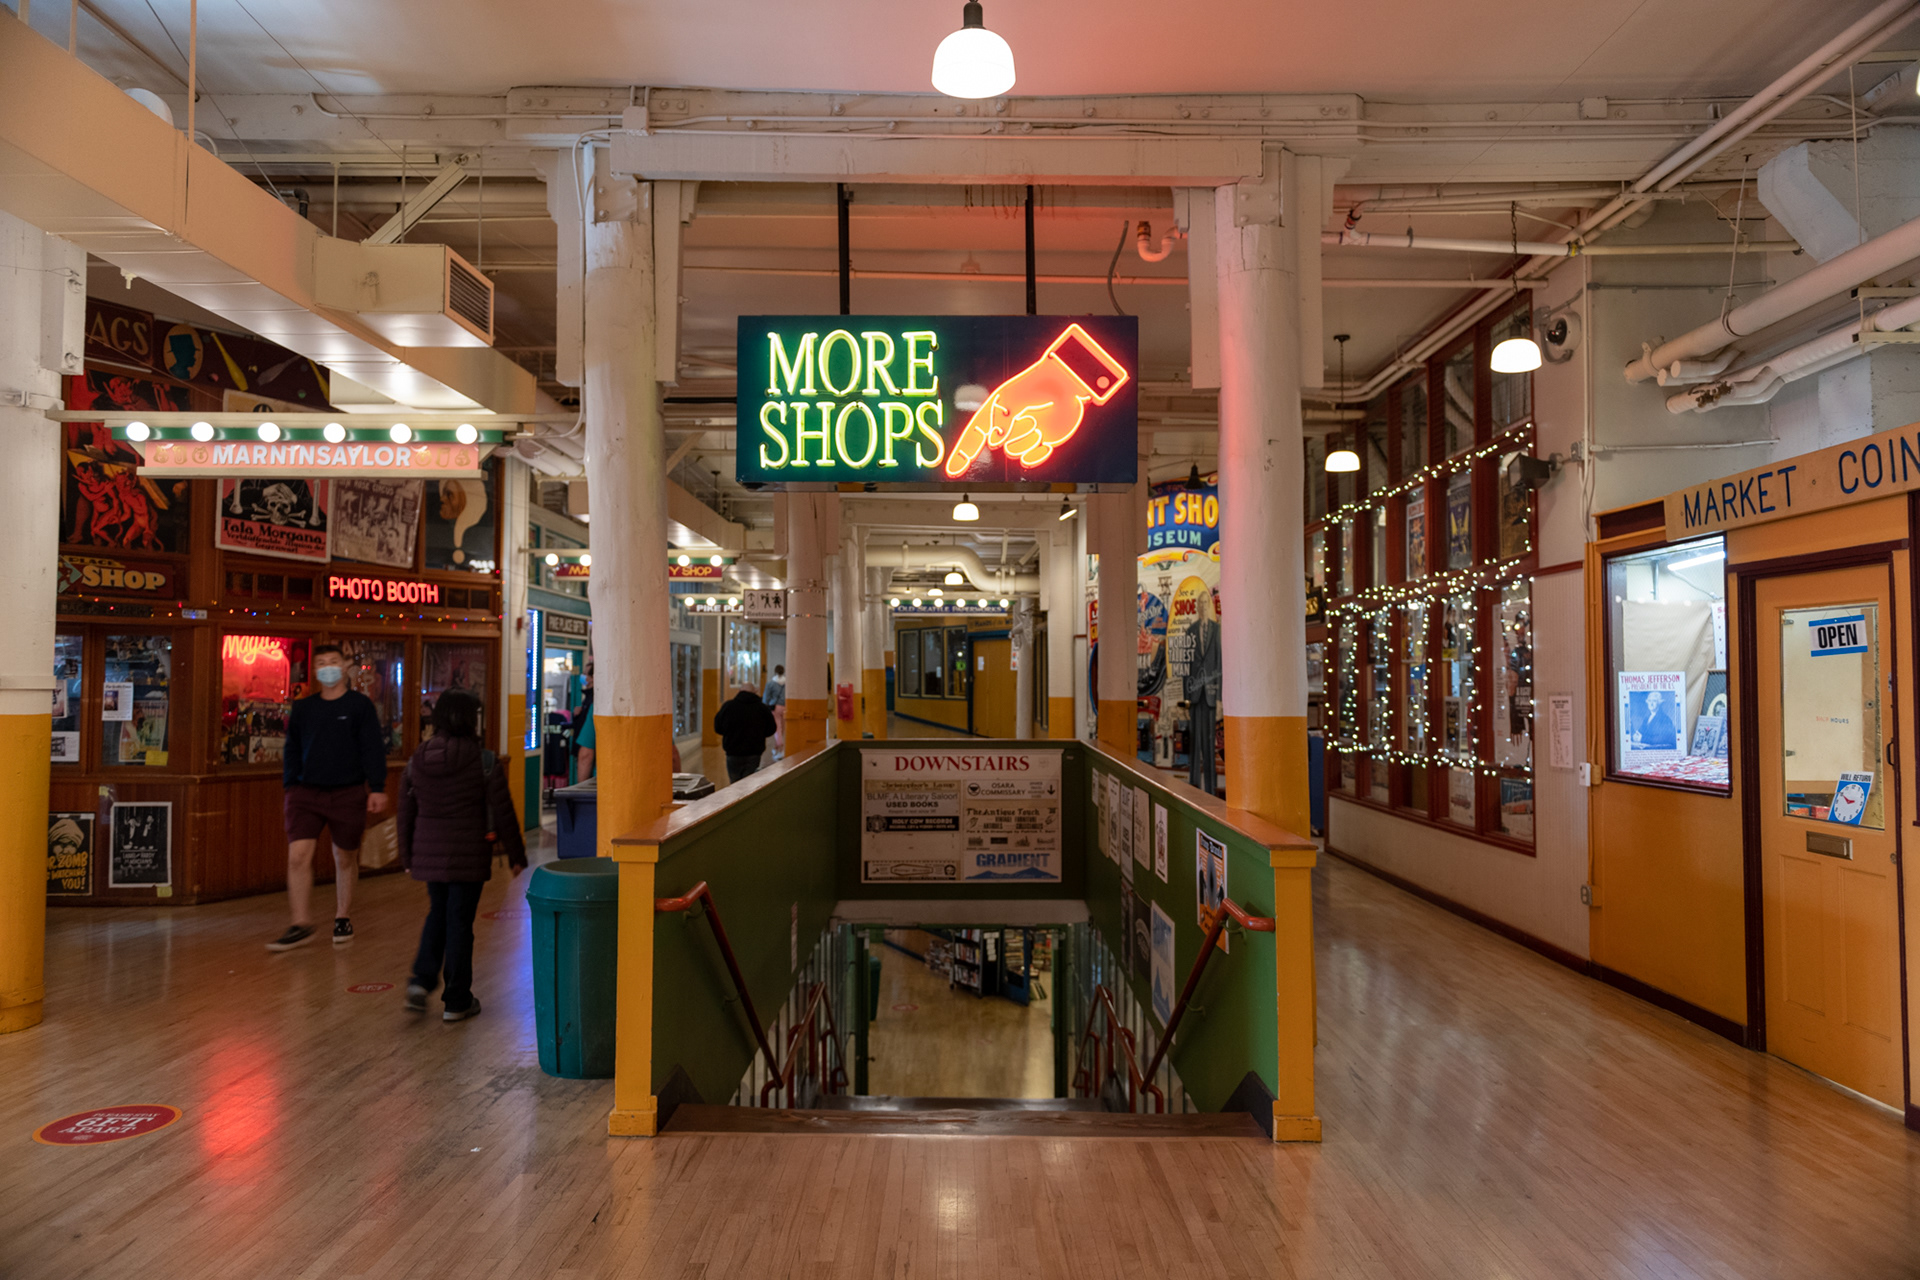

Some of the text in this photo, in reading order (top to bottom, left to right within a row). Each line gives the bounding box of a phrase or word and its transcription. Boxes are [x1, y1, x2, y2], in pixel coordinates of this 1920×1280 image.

[87, 311, 148, 355] AGS
[766, 329, 939, 396] MORE
[760, 400, 945, 469] SHOPS
[212, 443, 411, 467] MARNINSAYLOR
[1684, 433, 1920, 528] MARKET COIN
[1147, 492, 1219, 529] NT SHO
[1148, 530, 1201, 548] SEUM
[81, 565, 166, 590] SHOP
[682, 566, 712, 576] SHOP
[329, 576, 439, 604] PHOTO BOOTH
[696, 604, 744, 612] PIKE PLA
[1174, 598, 1196, 616] SHOE
[1168, 633, 1196, 648] WORLD'S
[1818, 623, 1857, 648] OPEN
[1173, 663, 1190, 676] MAN
[1621, 674, 1680, 684] THOMAS JEFFERSON
[895, 755, 1029, 771] DOWNSTAIRS
[1853, 774, 1871, 782] RETURN
[901, 793, 929, 801] Literary
[982, 808, 1015, 816] Antique
[57, 851, 88, 868] ZOMB
[976, 853, 1050, 867] GRADIENT
[61, 877, 86, 890] YOU!
